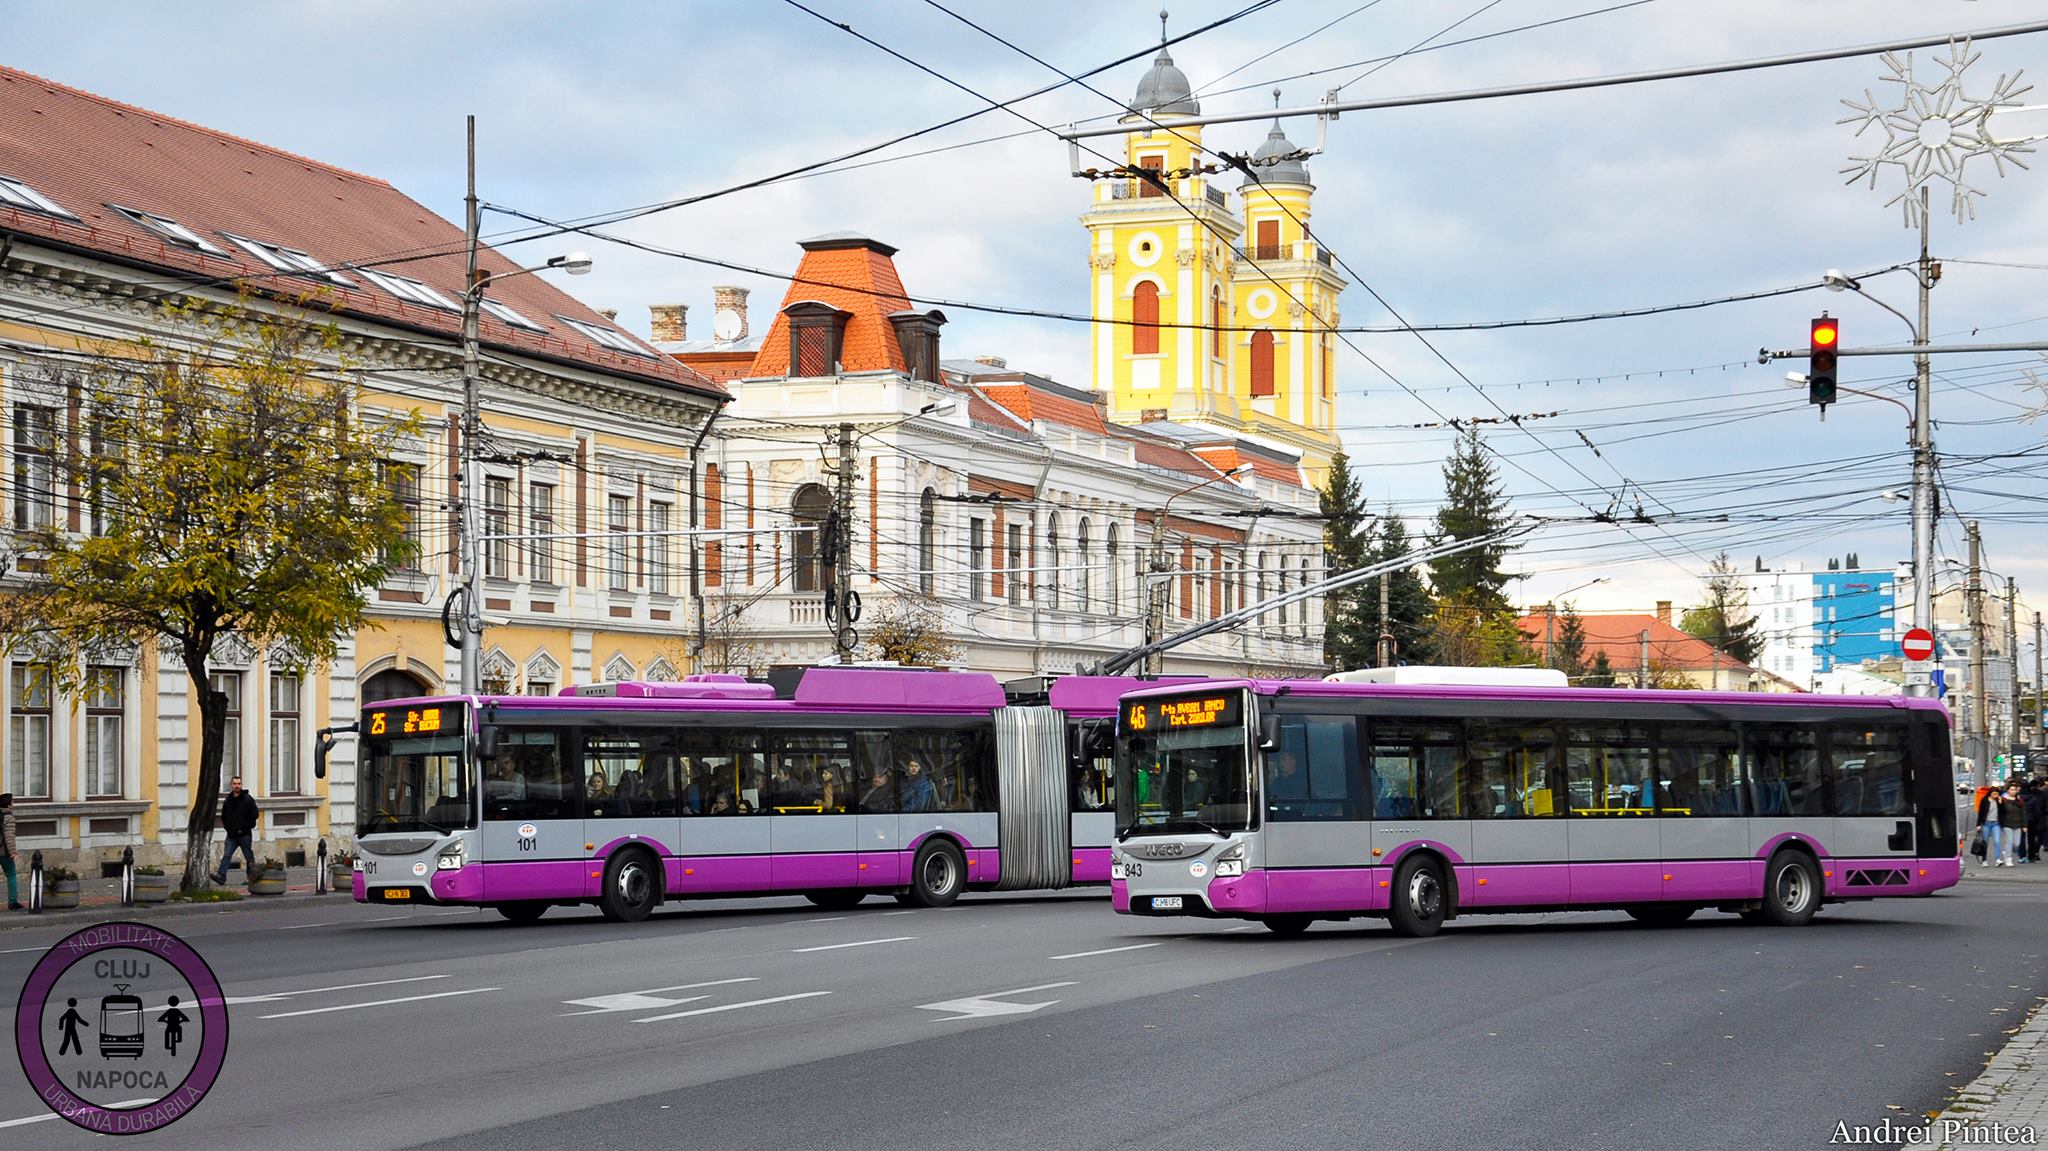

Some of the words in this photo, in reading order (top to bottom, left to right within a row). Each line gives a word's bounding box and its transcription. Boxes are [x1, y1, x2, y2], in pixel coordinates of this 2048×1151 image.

[371, 713, 386, 734] 25
[1130, 706, 1146, 729] 46
[517, 837, 537, 851] 101
[1145, 843, 1184, 857] IVECO
[364, 861, 377, 874] 101
[1125, 863, 1142, 877] 843
